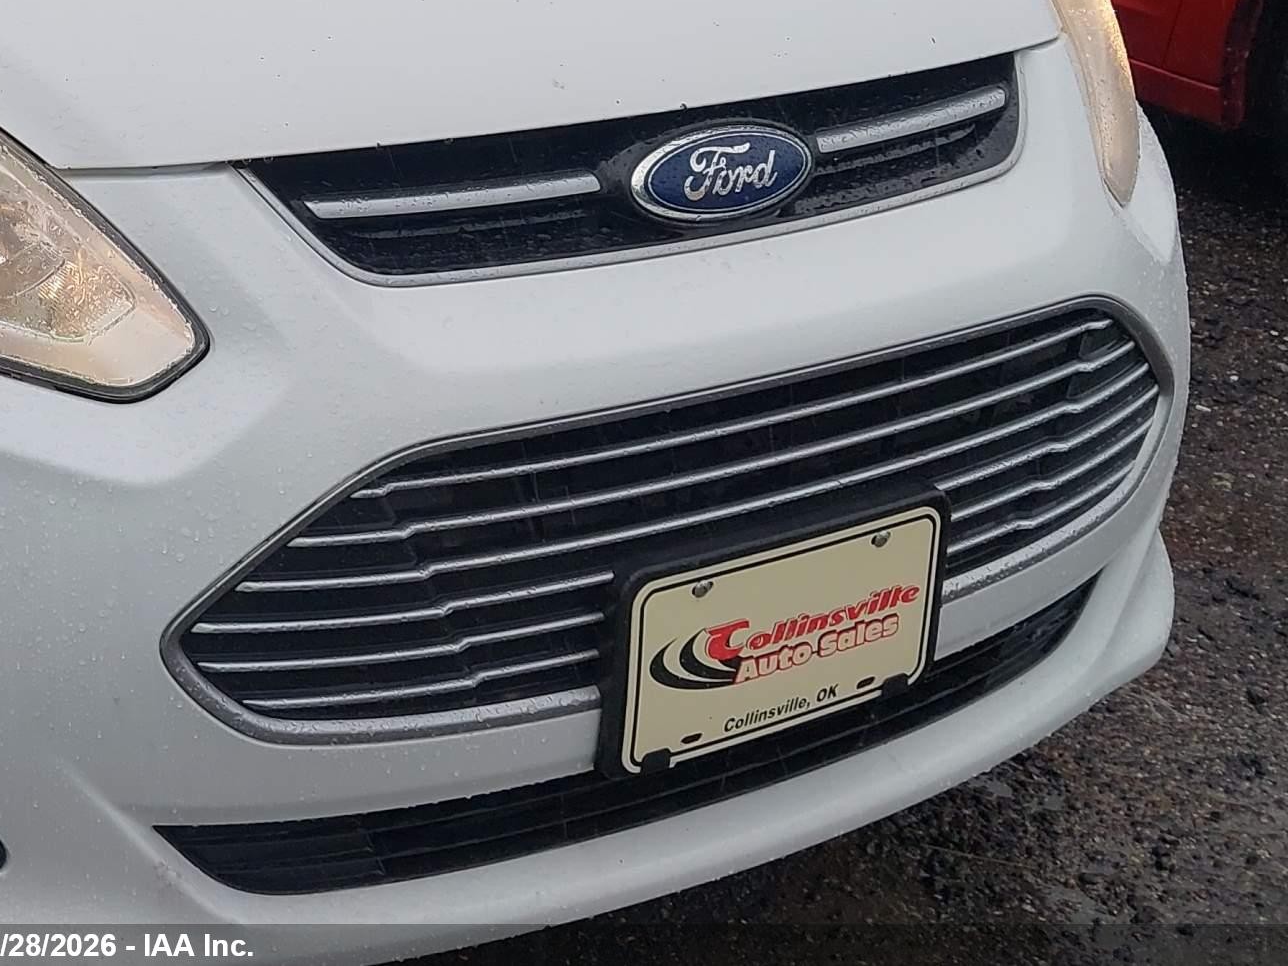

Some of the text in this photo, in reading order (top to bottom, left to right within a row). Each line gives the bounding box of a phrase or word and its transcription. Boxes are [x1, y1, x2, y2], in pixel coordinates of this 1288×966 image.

[684, 142, 778, 201] Ford
[705, 585, 921, 662] Collinsville
[724, 683, 839, 733] Collinsville, OK
